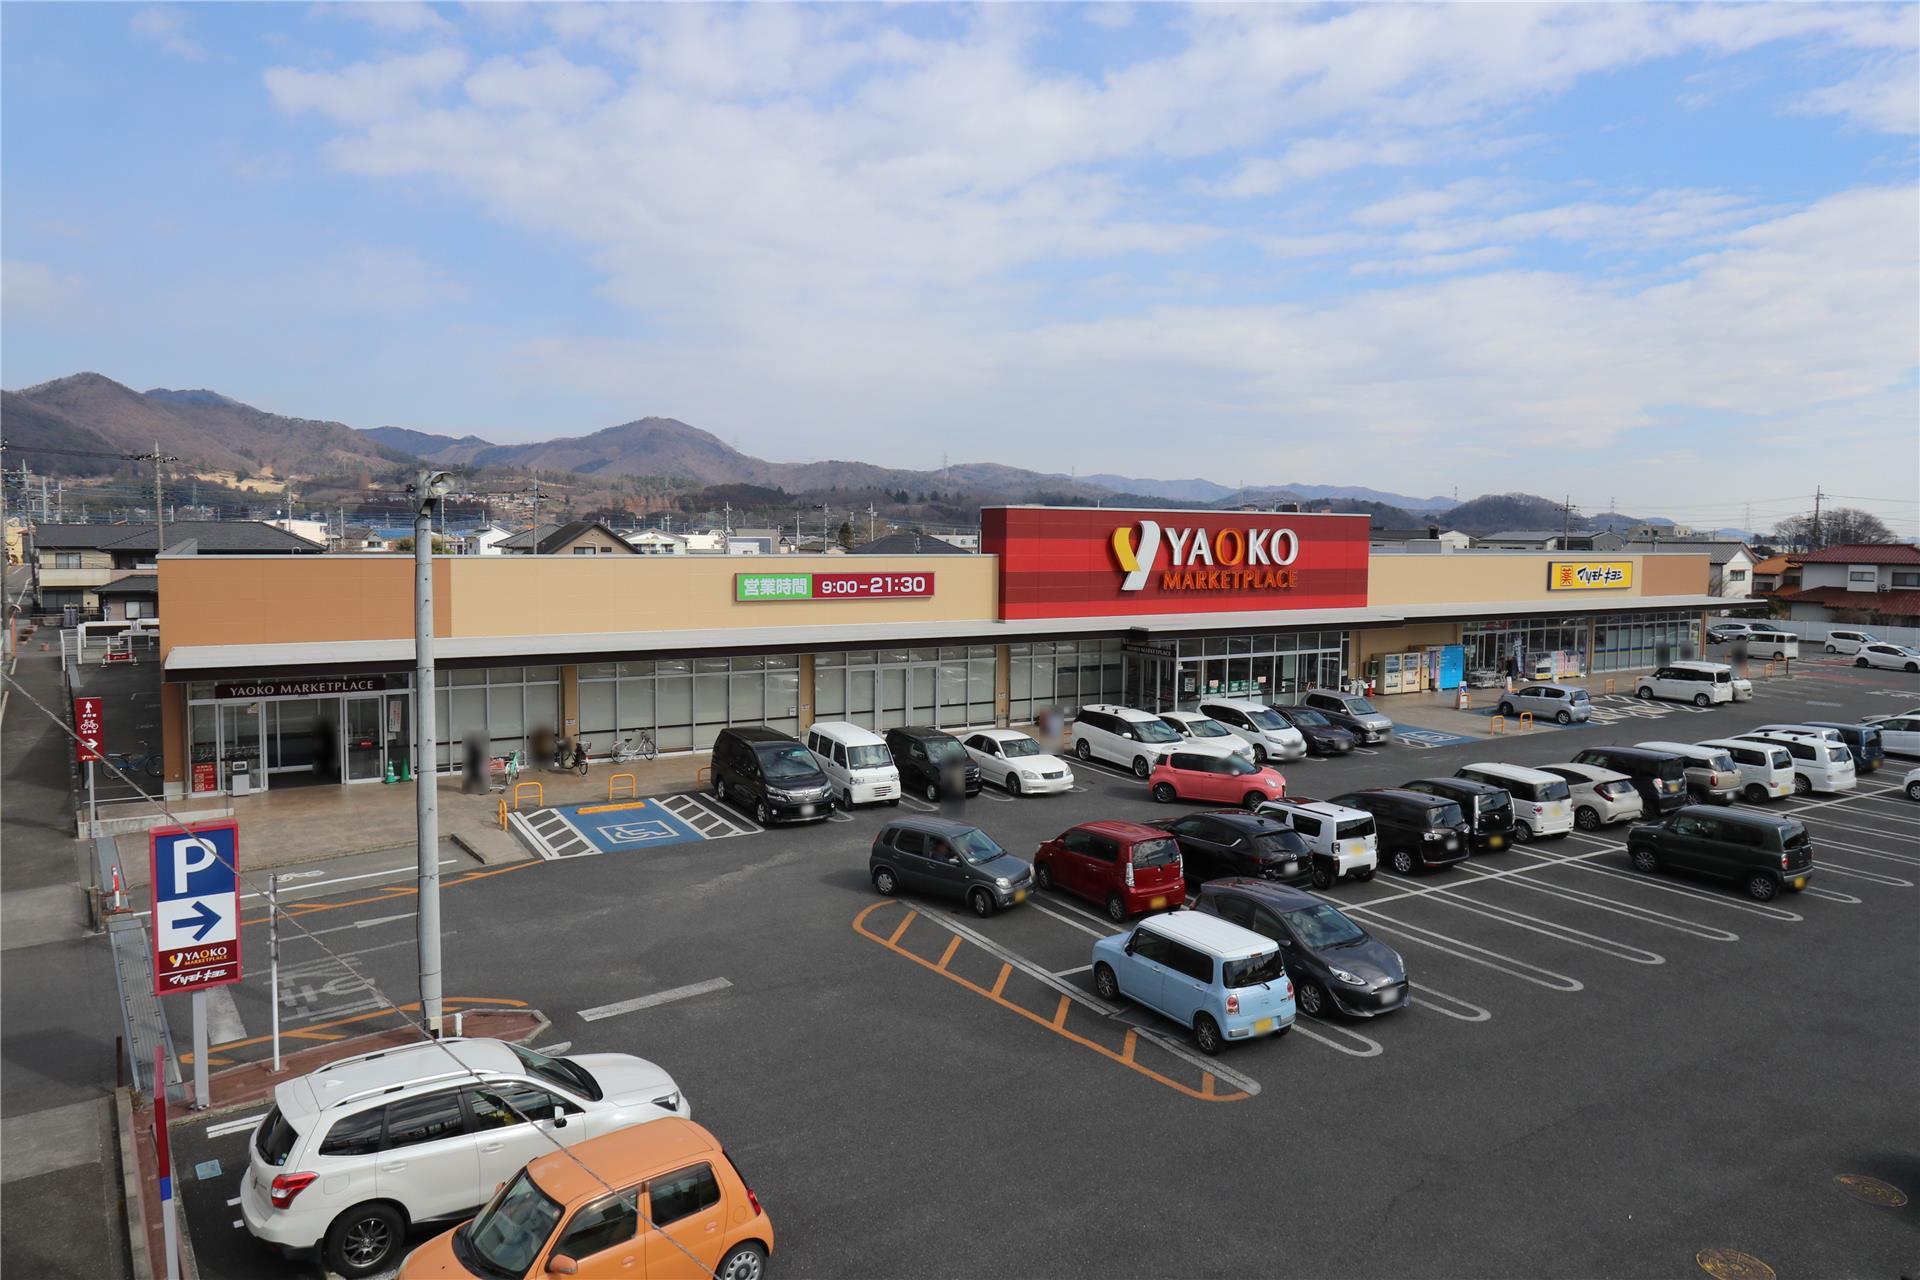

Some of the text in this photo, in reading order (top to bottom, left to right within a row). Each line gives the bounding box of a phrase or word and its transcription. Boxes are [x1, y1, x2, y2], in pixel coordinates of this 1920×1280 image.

[1164, 527, 1299, 566] YAOKO
[744, 578, 808, 596] 営業時間
[1163, 569, 1298, 591] MARKETPLACE
[230, 680, 374, 697] YAOKO MARKETPLACE
[173, 837, 217, 894] P
[184, 946, 228, 961] YAOKO
[184, 955, 228, 965] MARKETPLACE
